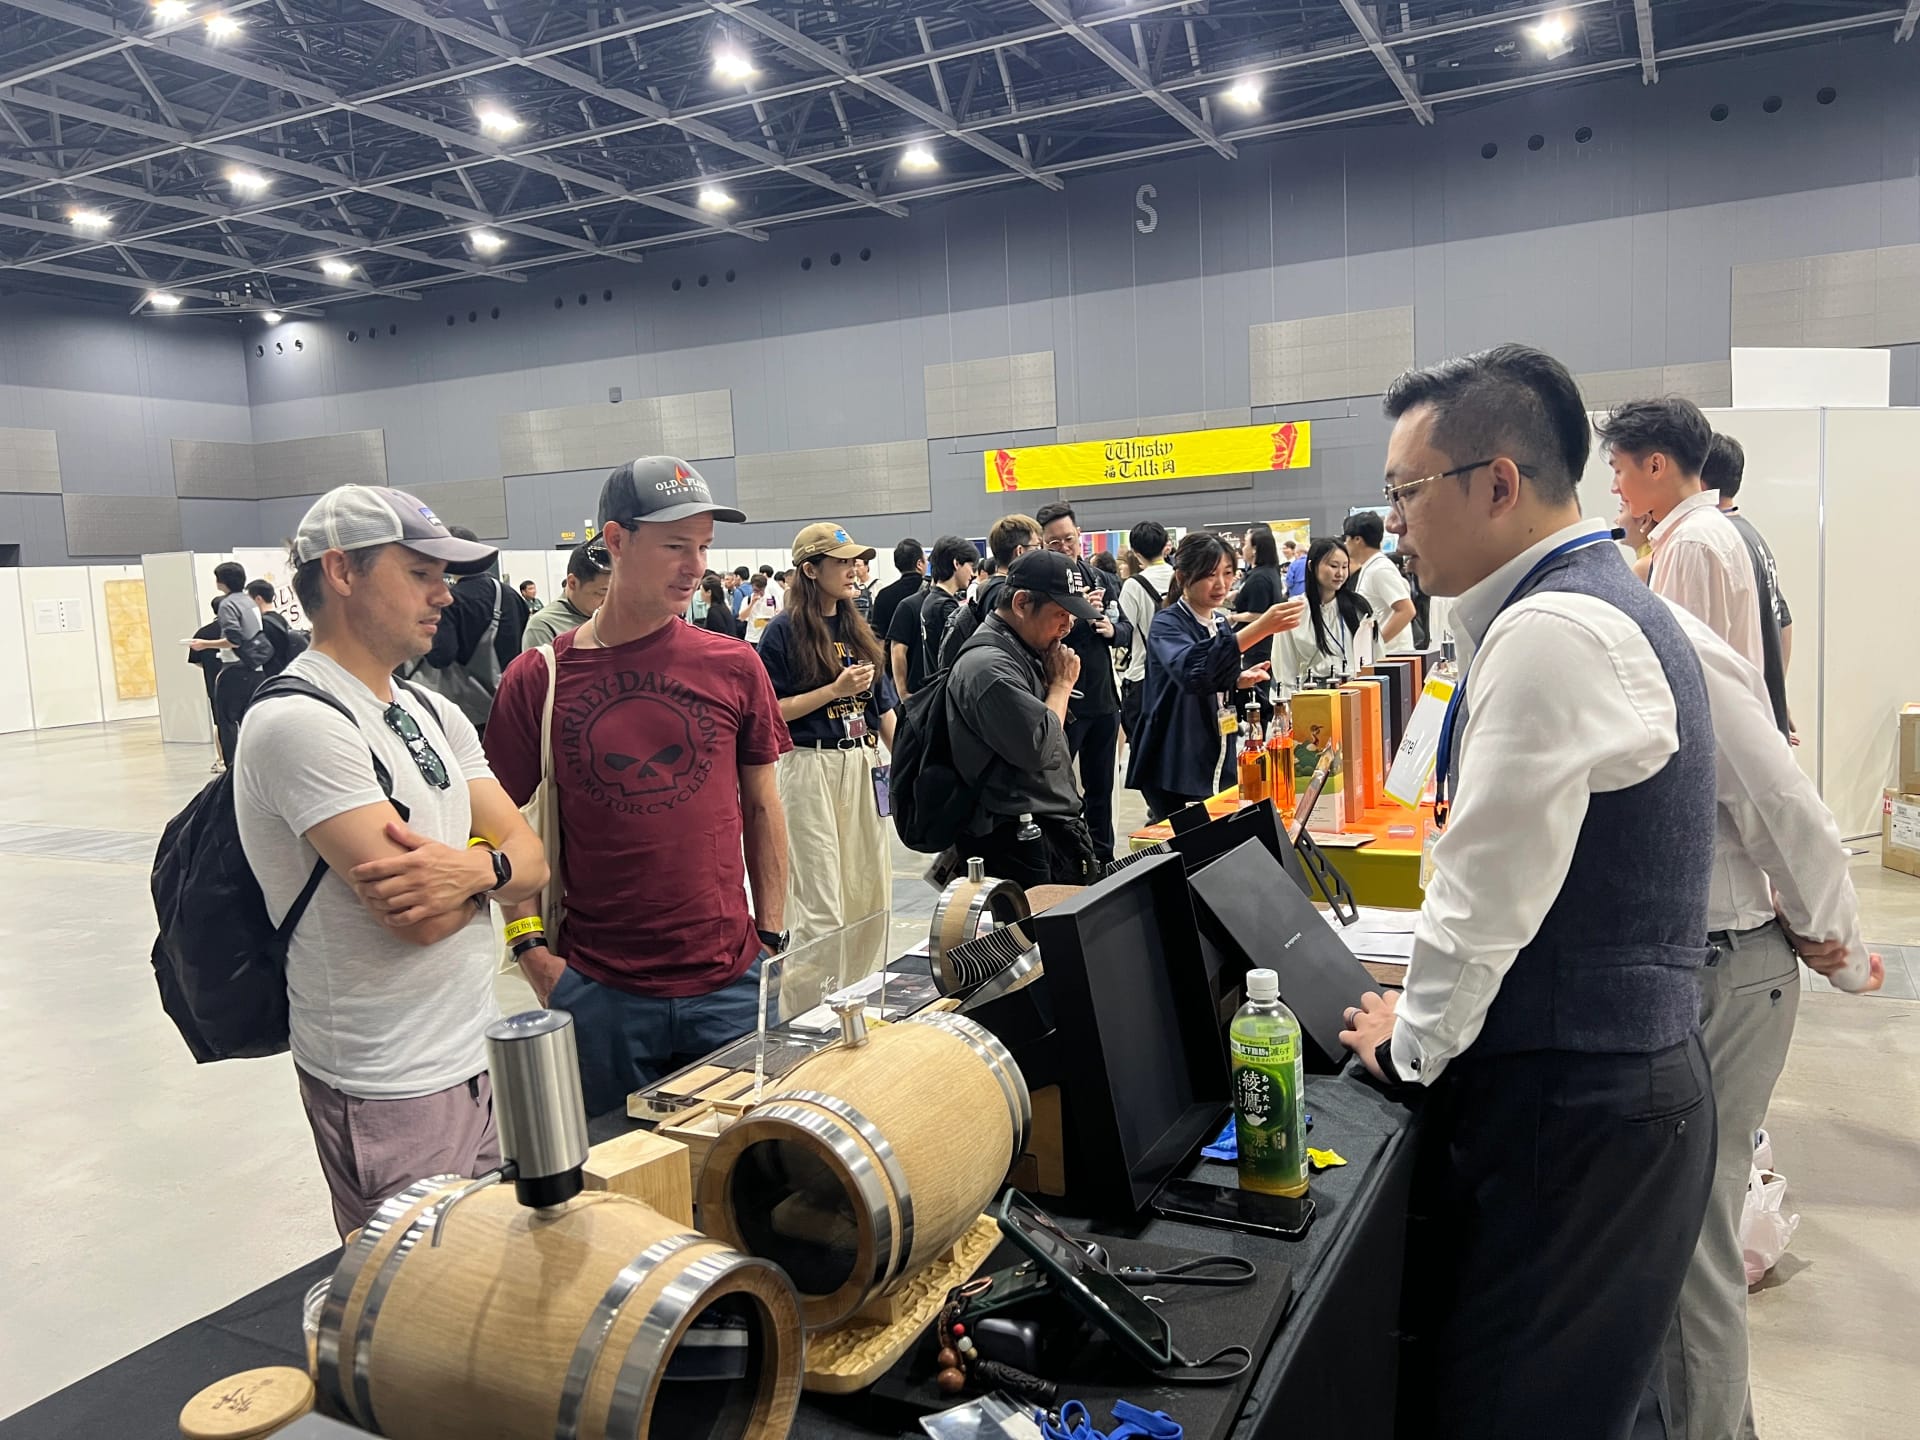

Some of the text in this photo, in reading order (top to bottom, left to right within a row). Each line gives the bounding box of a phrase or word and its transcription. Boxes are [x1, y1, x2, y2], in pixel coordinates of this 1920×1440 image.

[1136, 184, 1158, 234] S
[1104, 440, 1173, 460] Whisky
[1119, 460, 1159, 478] Talk
[656, 480, 678, 491] OLD
[580, 758, 713, 815] MOTORCYCLES
[1242, 1070, 1262, 1114] 綾鷹
